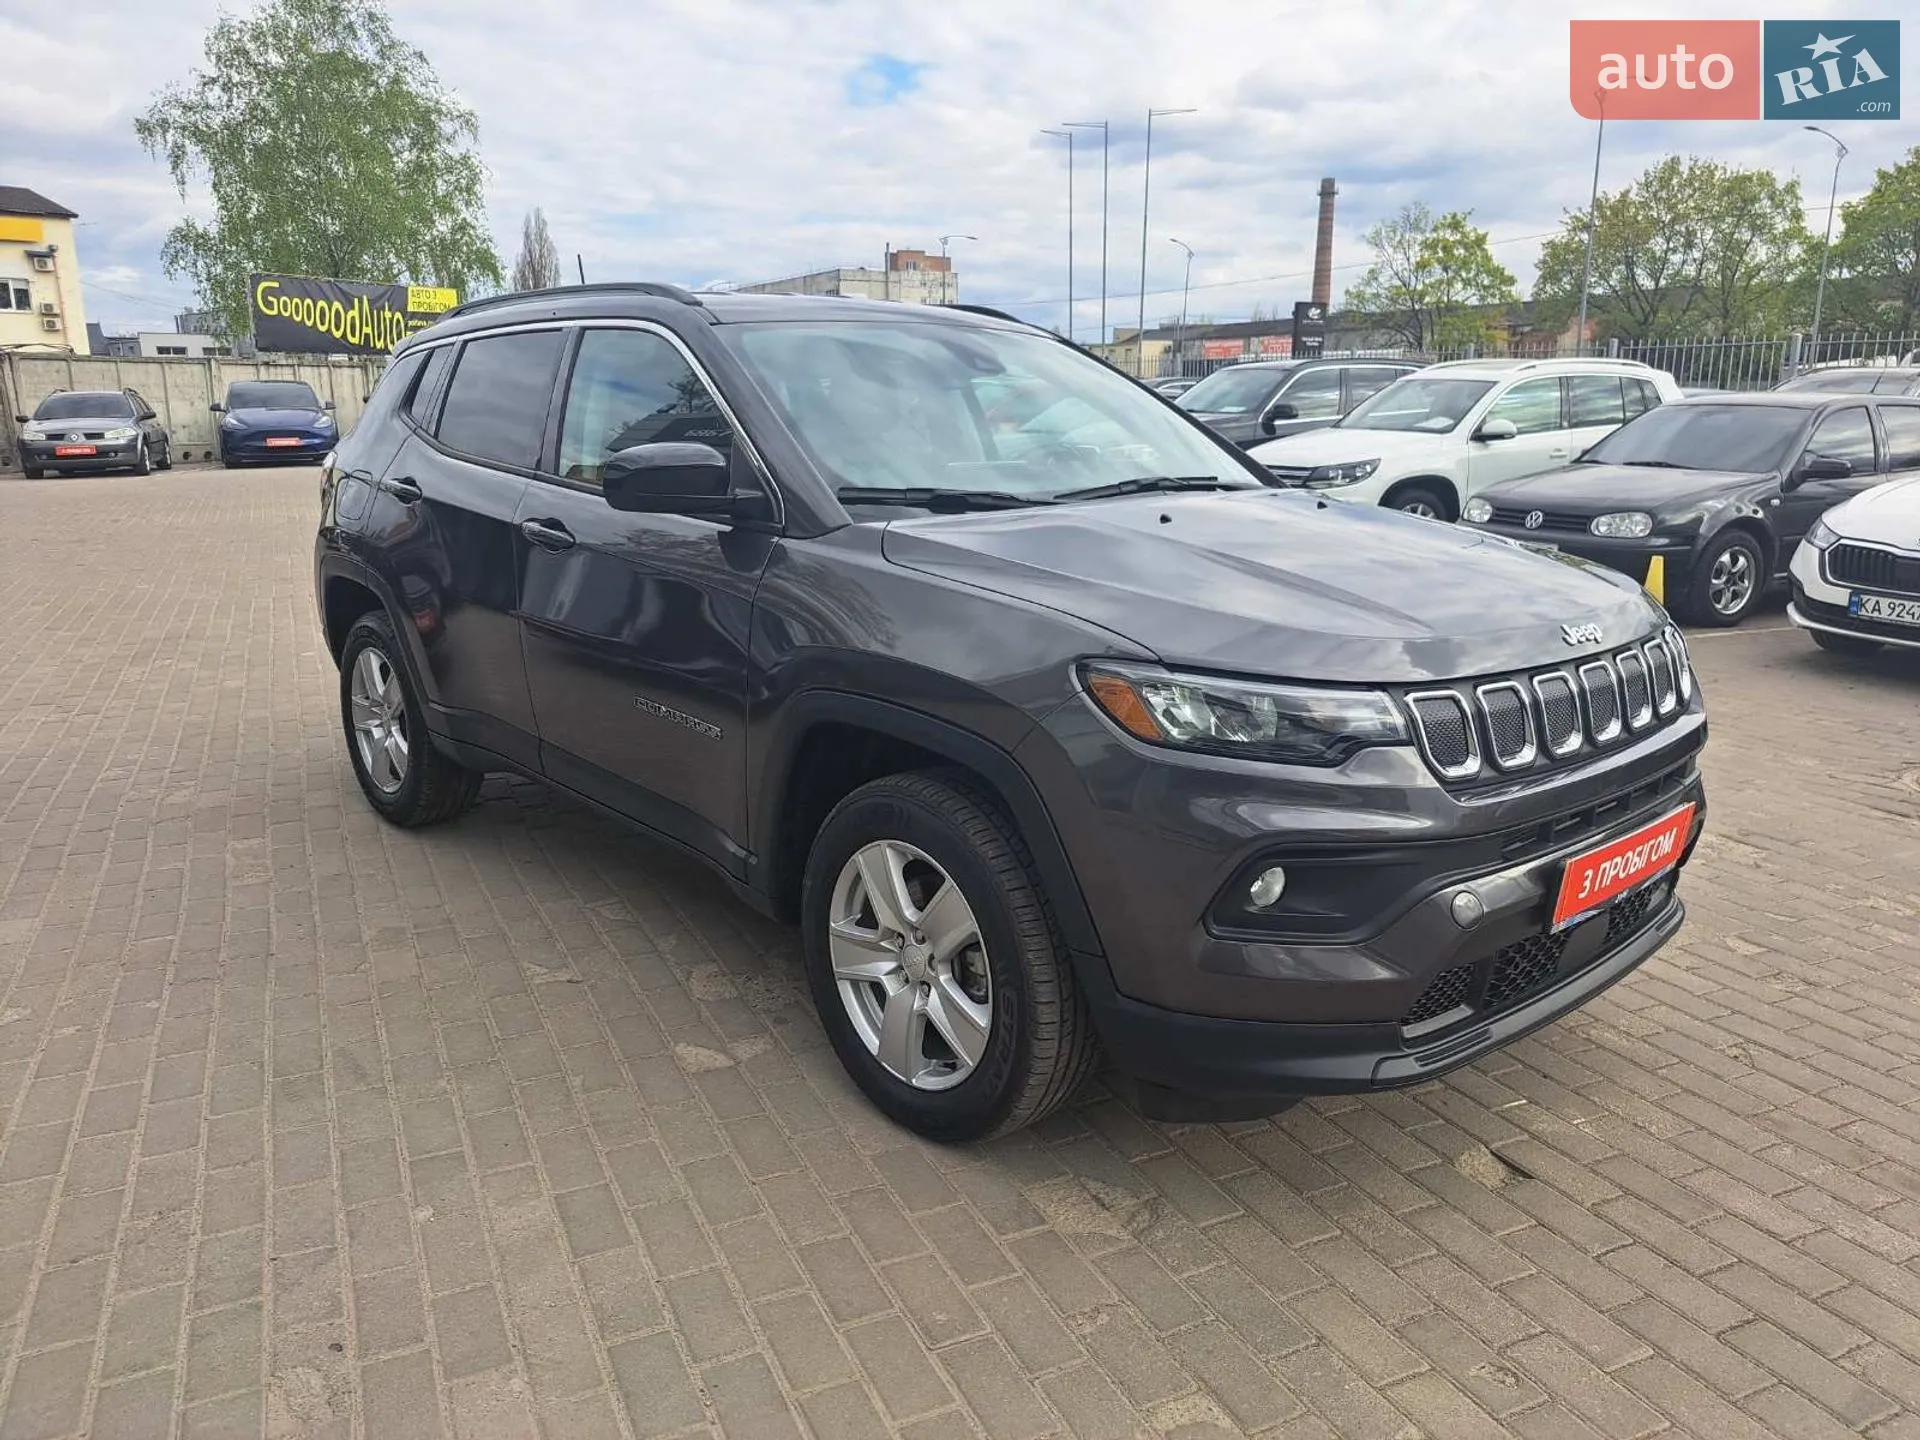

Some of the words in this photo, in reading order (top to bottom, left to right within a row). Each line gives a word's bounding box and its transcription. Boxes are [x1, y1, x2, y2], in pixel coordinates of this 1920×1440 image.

[1860, 597, 1882, 615] KA
[1560, 623, 1603, 646] Jeep
[1578, 869, 1594, 899] З
[1594, 827, 1678, 893] ПРОБІГОМ
